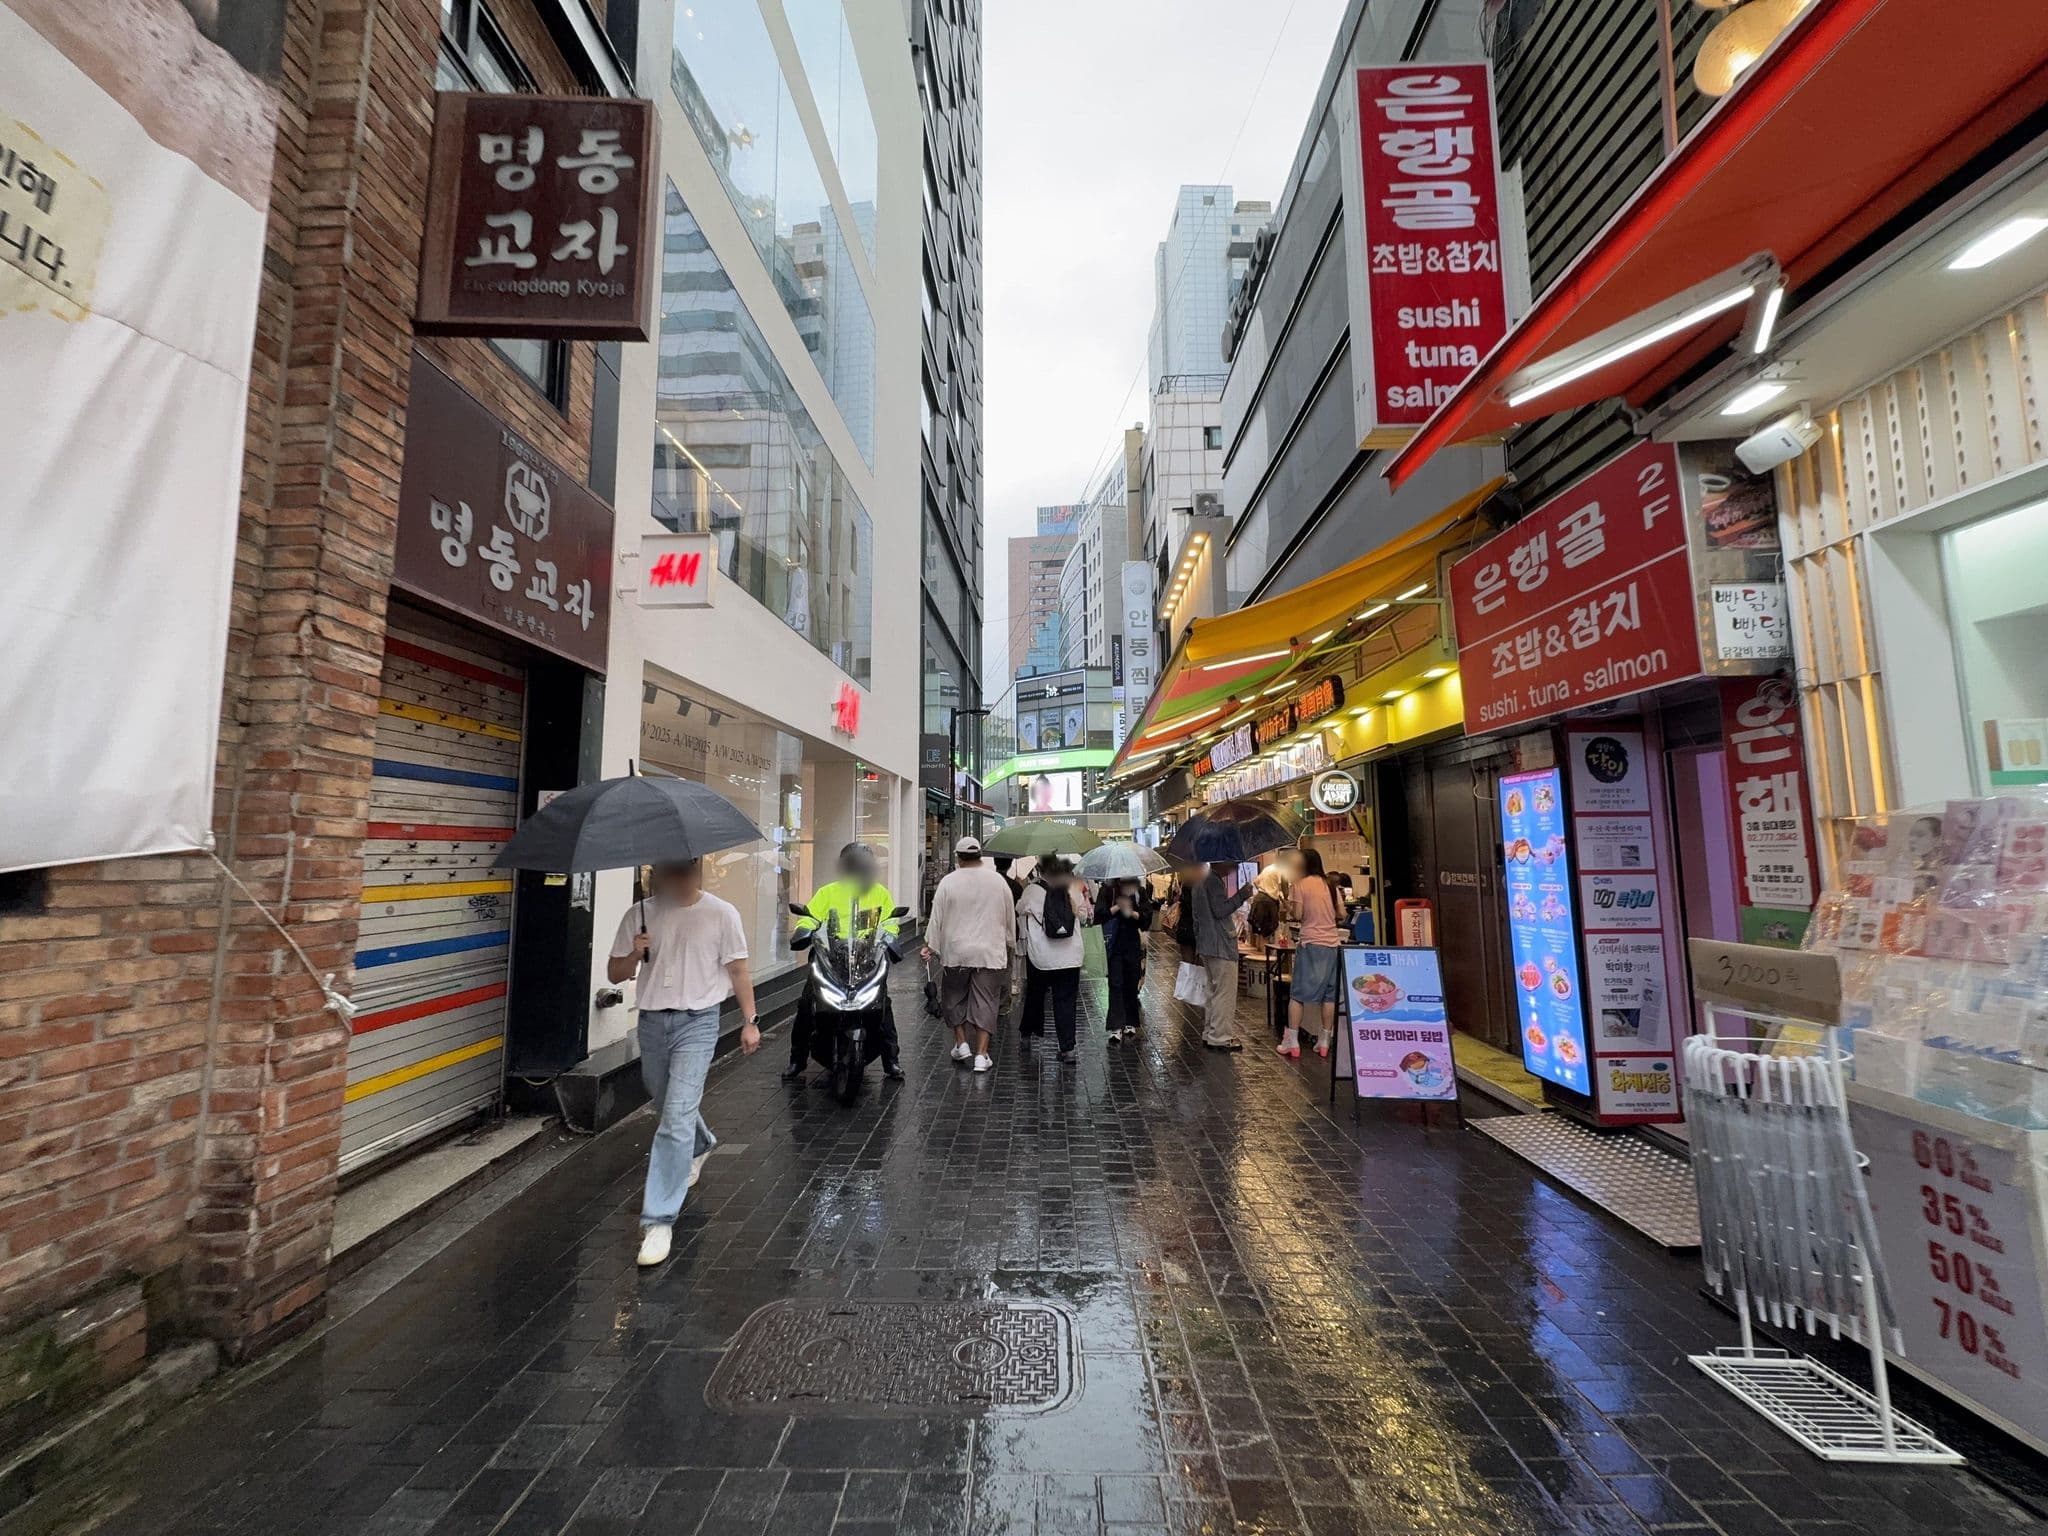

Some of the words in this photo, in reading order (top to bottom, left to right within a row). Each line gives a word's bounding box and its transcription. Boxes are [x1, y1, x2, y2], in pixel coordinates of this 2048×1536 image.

[478, 125, 635, 195] 명동
[1374, 74, 1480, 230] 은행골
[464, 206, 629, 275] 교자
[1373, 240, 1498, 275] 초밥&참치
[577, 278, 626, 298] Kyoja
[1398, 298, 1480, 329] sushi
[1405, 340, 1478, 368] tuna
[431, 500, 594, 632] 명동교자
[650, 553, 701, 588] H&M
[1472, 501, 1606, 616] 은행골
[1492, 582, 1641, 680] 초밥&참치
[1479, 690, 1518, 723] sushi
[1528, 680, 1570, 709] tuna
[1582, 649, 1668, 692] salmon
[1358, 1029, 1381, 1041] 장어
[1384, 1029, 1418, 1042] 한마리
[1420, 1030, 1443, 1043] 덮밥
[1921, 1185, 1989, 1236] 35%
[1928, 1240, 1999, 1295] 50%
[1931, 1296, 2006, 1355] 70%
